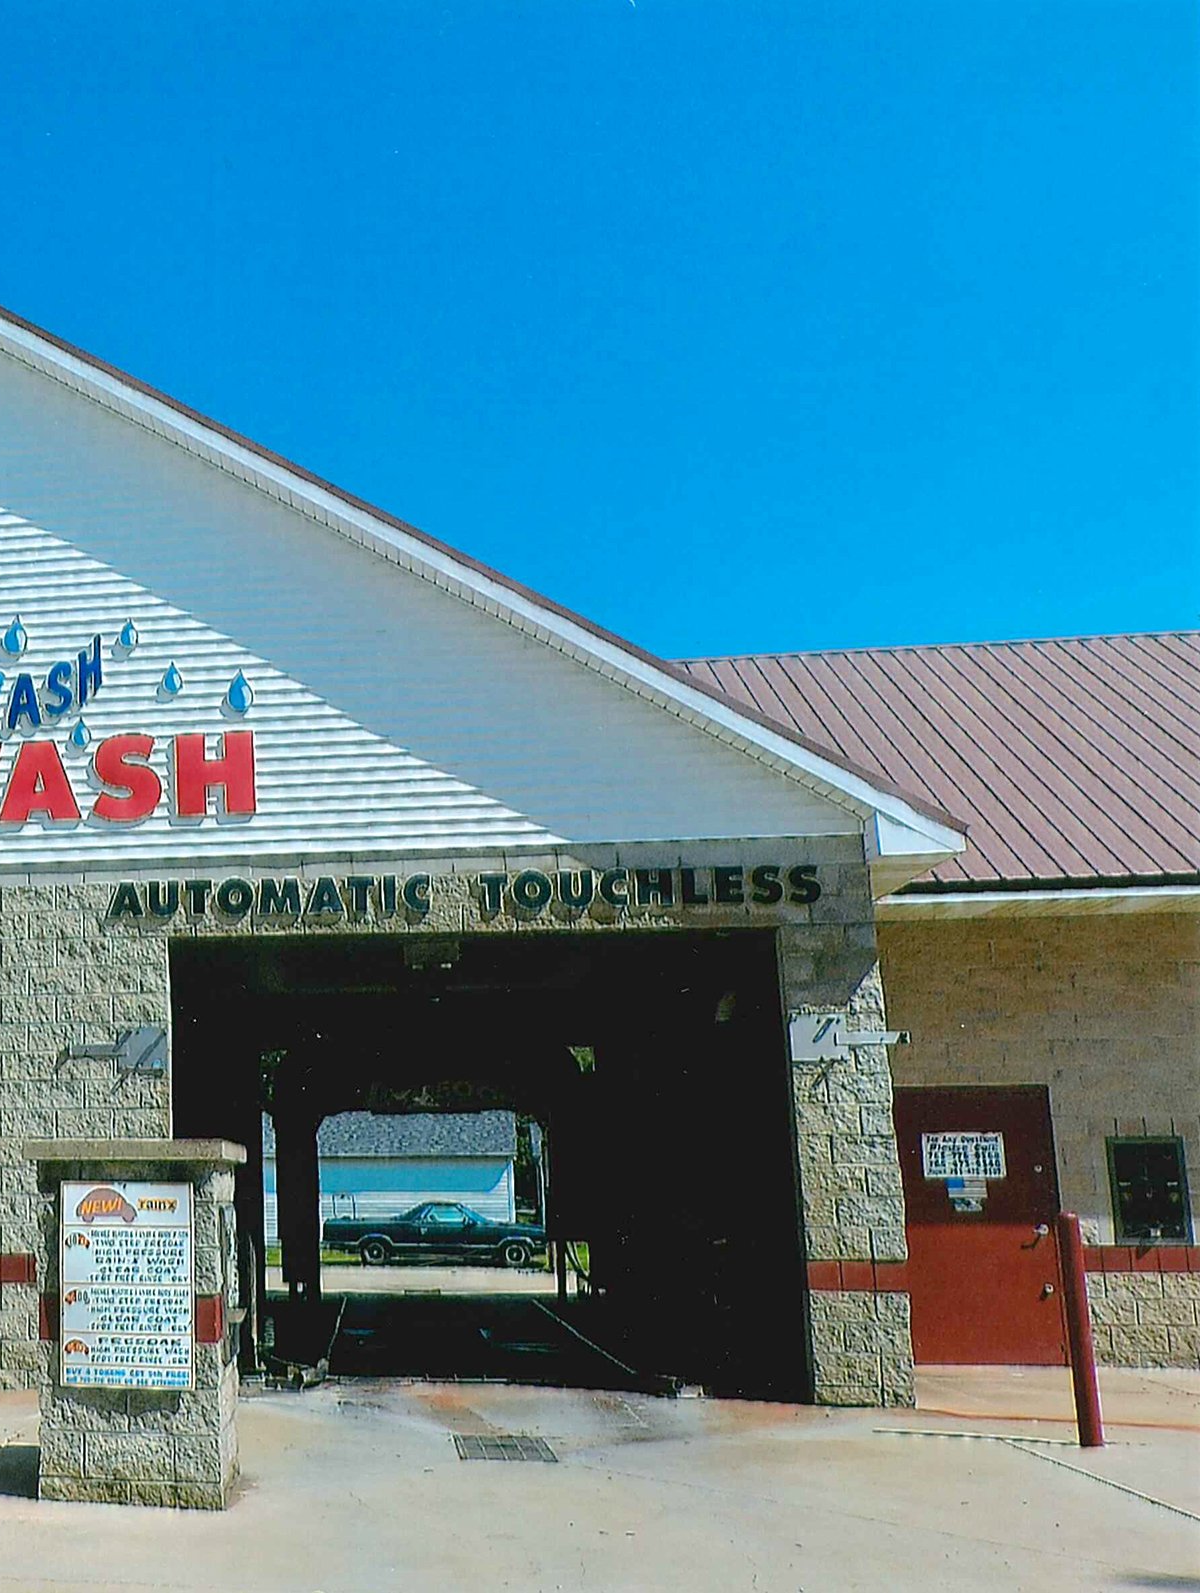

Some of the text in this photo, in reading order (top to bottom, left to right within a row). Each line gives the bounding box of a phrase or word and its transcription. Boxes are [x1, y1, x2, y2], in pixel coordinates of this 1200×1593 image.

[109, 864, 822, 918] AUTOMATIC TOUCHLESS
[81, 1197, 123, 1215] NEW!
[146, 1257, 185, 1265] WASH
[147, 1315, 178, 1323] COAT
